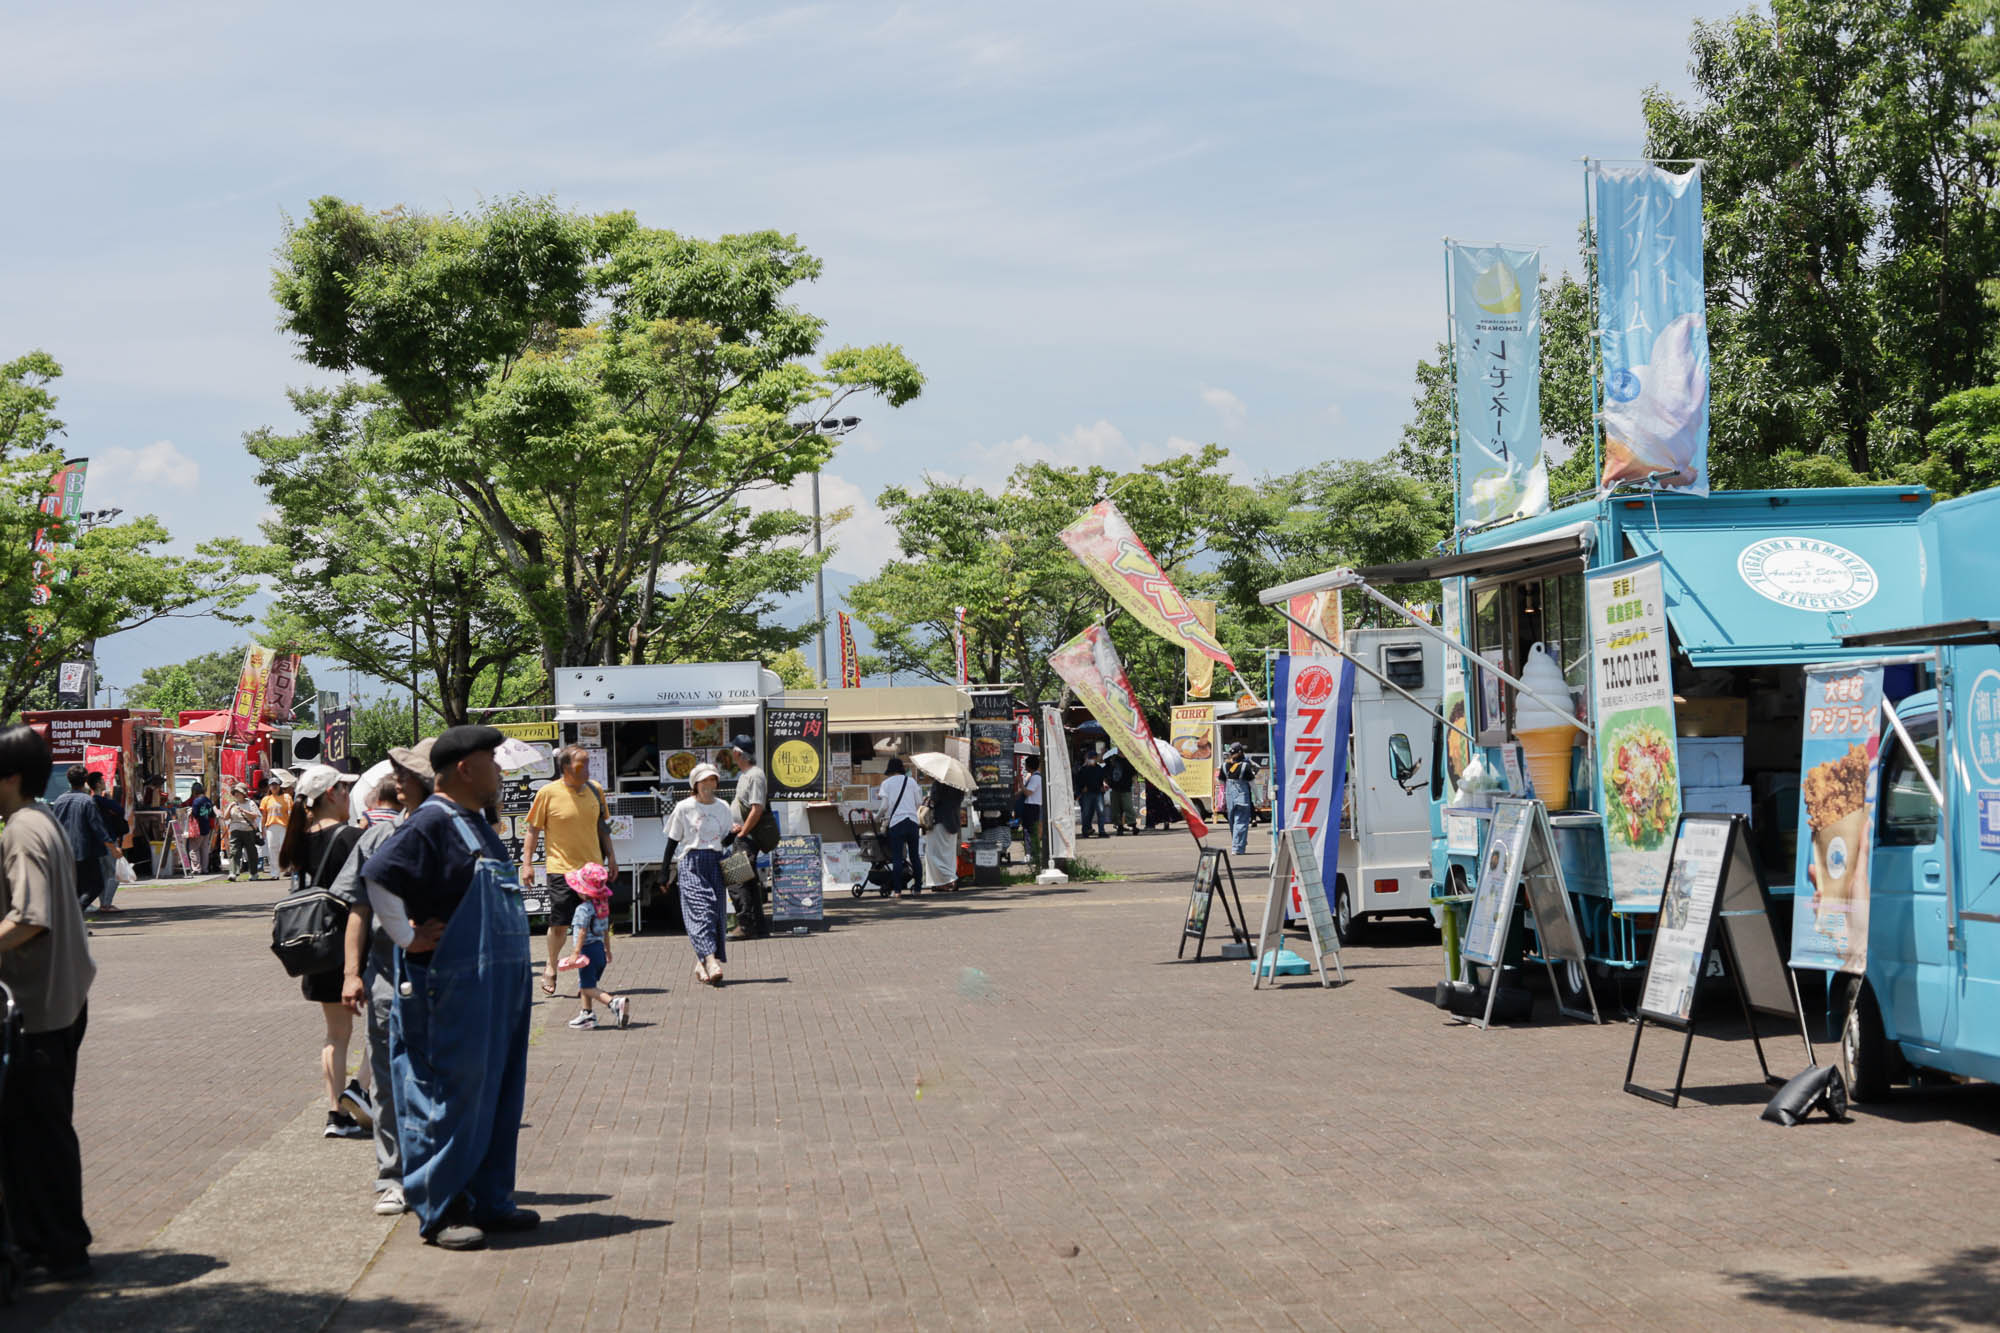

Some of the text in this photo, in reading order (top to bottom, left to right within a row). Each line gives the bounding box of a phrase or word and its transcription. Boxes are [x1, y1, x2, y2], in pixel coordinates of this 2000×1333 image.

[1653, 195, 1680, 305] ソフト
[1618, 192, 1653, 333] クリーム
[1800, 541, 1871, 582] KAMAKURA
[1602, 650, 1659, 690] TACO RICE
[656, 691, 701, 700] SHONAN
[728, 689, 756, 697] TORA
[1824, 675, 1864, 703] 大きな
[1176, 709, 1208, 719] CURRY
[1810, 704, 1878, 734] アジフライ
[51, 719, 113, 729] Kitchen Homie
[768, 720, 800, 728] こだわりの
[803, 719, 822, 736] 肉
[52, 729, 101, 739] Good Family
[774, 728, 800, 736] 美味しい
[783, 763, 814, 776] TORA
